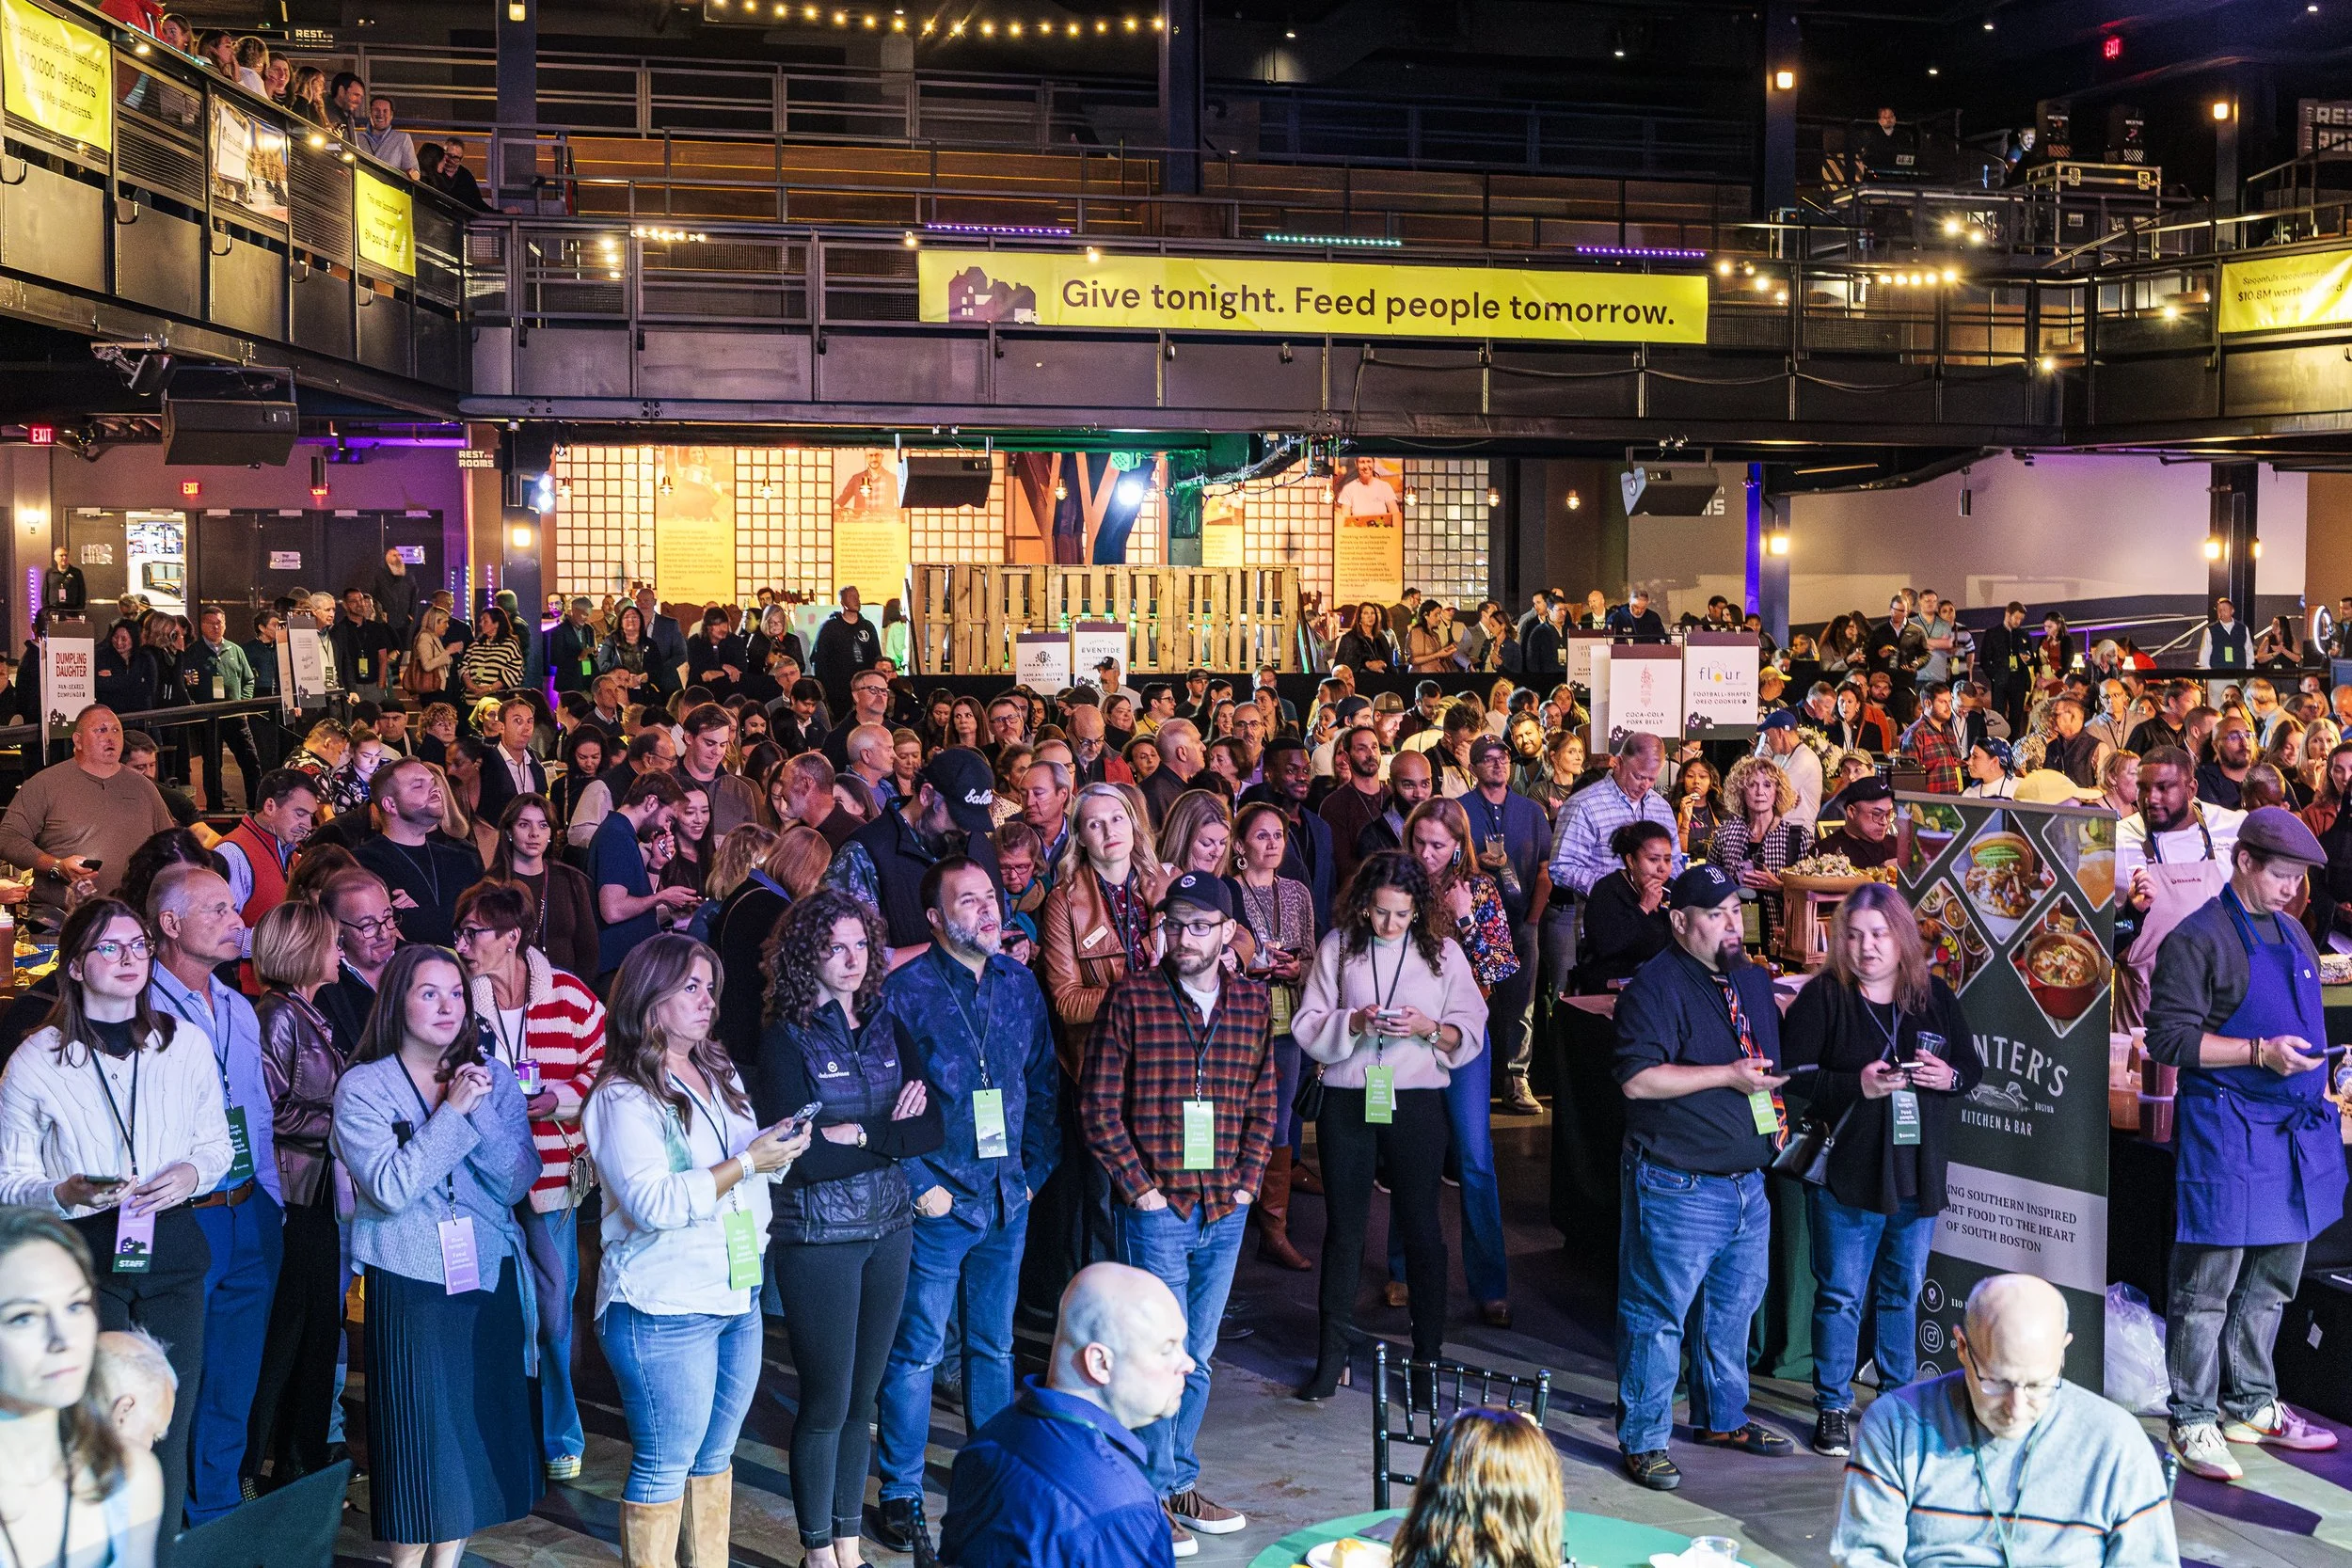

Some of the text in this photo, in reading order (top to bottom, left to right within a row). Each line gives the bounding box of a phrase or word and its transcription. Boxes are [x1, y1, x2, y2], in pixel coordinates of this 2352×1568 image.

[295, 29, 323, 39] REST
[1063, 279, 1675, 326] Give tonight. Feed people tomorrow.
[32, 428, 53, 443] EXIT
[458, 451, 485, 459] REST
[458, 459, 495, 468] ROOMS
[183, 482, 199, 495] EXIT
[56, 665, 87, 678] DAUGHTER
[1972, 1034, 2069, 1098] NTER'S
[1961, 1109, 2033, 1137] KITCHEN & BAR
[1966, 1189, 2024, 1212] SOUTHERN
[2026, 1202, 2078, 1225] INSPIRED
[1966, 1207, 1996, 1224] FOOD
[1998, 1214, 2013, 1227] TO
[2015, 1218, 2037, 1234] THE
[2039, 1225, 2076, 1243] HEART
[1946, 1220, 2042, 1254] OF SOUTH BOSTON
